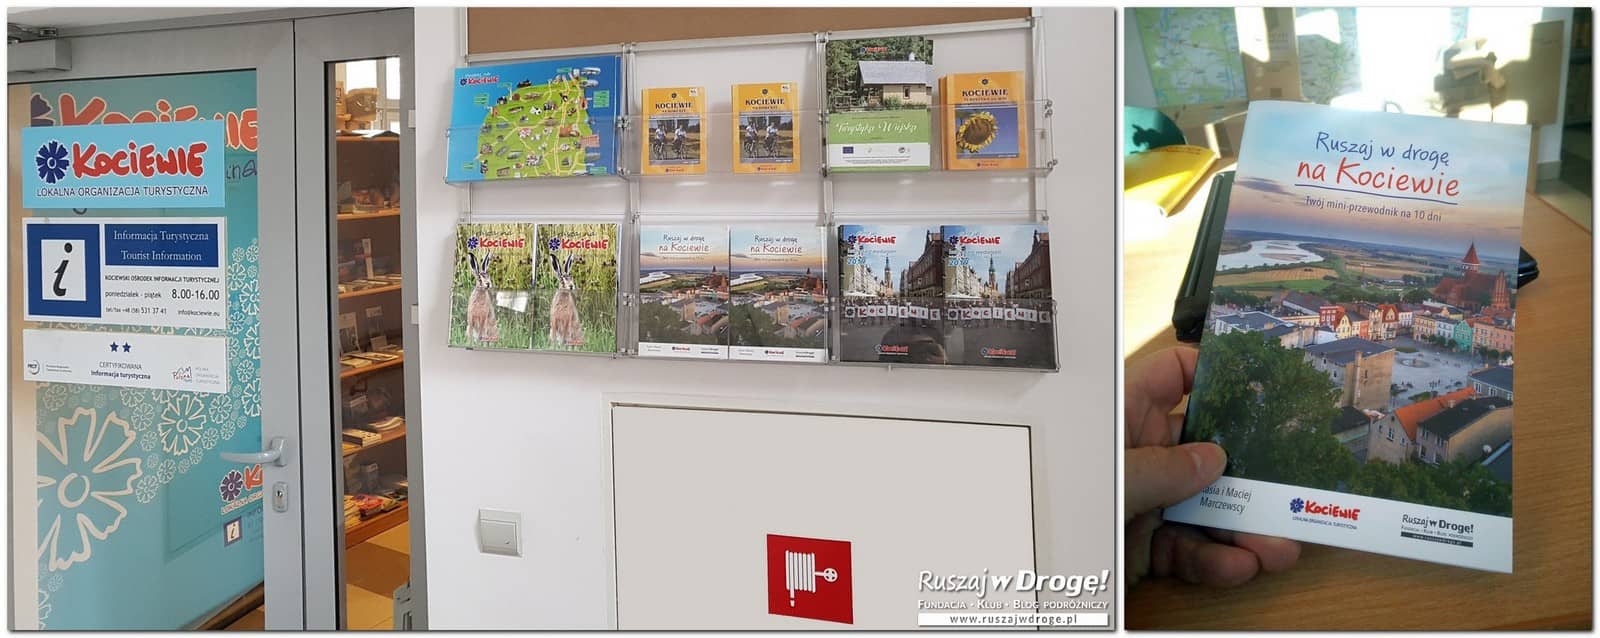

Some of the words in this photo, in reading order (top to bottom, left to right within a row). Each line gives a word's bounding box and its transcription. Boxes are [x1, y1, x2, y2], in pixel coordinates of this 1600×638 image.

[1315, 131, 1374, 160] Ruszaj
[1380, 144, 1394, 158] w
[1402, 144, 1450, 170] drogę
[1297, 160, 1325, 182] na
[1336, 156, 1460, 197] Kociewie
[37, 186, 76, 197] LOKALNA
[78, 186, 140, 196] ORGANIZACJA
[143, 185, 208, 196] TURYSTYCZNA
[1306, 196, 1324, 210] Twój
[1326, 200, 1398, 217] mini-przewodnik
[1400, 210, 1412, 218] na
[1414, 210, 1424, 220] 10
[1427, 211, 1442, 222] dni
[114, 230, 158, 242] Informacja
[160, 230, 209, 244] Turystyczna
[670, 242, 710, 252] Kociewie
[763, 242, 802, 254] Kociewie
[120, 250, 150, 261] Tourist
[152, 250, 202, 262] Information
[172, 288, 220, 300] 8.00-16.00
[99, 362, 142, 370] CERTYFIKOWANA
[90, 370, 120, 379] Informacja
[120, 372, 150, 380] turystyczna
[1200, 484, 1220, 495] asia
[1226, 488, 1252, 502] Maciej
[1200, 496, 1246, 514] Marczewscy
[1402, 514, 1430, 528] Ruszaj
[1438, 520, 1474, 534] Drogę!
